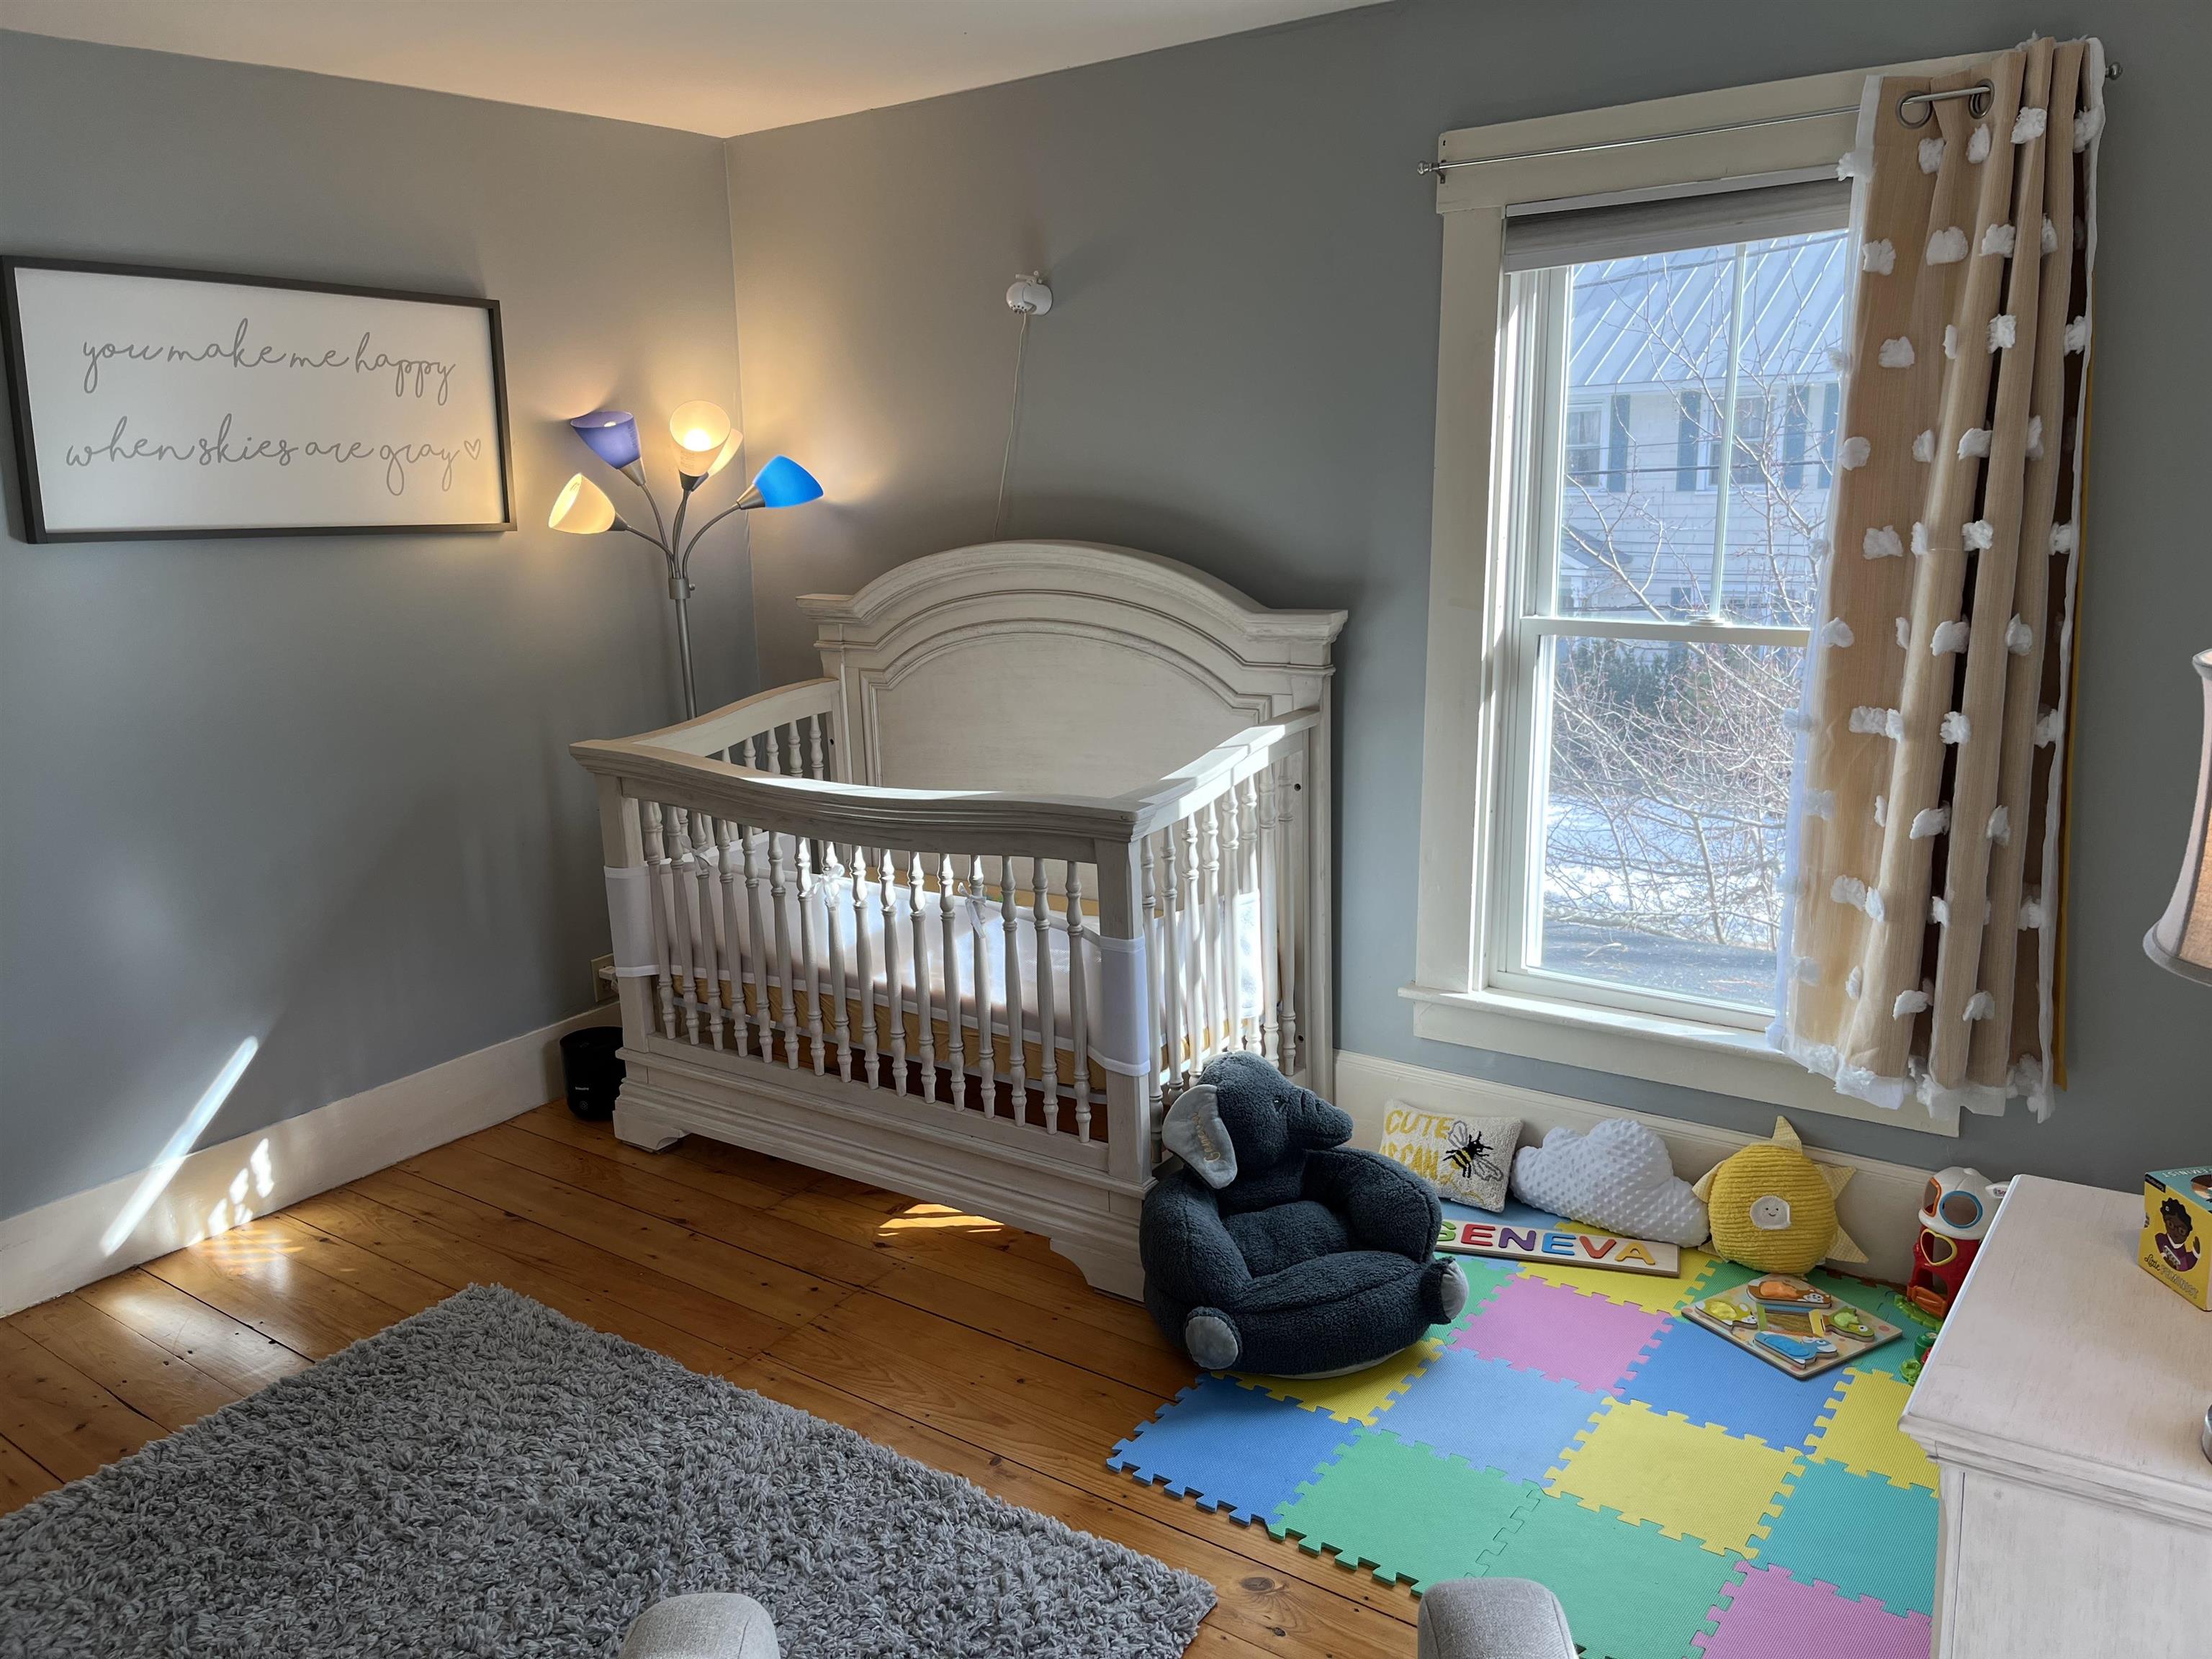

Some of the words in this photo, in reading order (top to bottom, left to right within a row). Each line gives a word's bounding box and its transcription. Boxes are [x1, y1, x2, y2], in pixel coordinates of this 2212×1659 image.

[83, 341, 163, 394] you
[167, 318, 286, 368] make
[289, 349, 349, 368] me
[355, 331, 456, 406] happy
[66, 415, 194, 467] when
[199, 413, 299, 466] skies
[305, 441, 374, 463] are
[379, 444, 460, 495] gray
[1385, 1110, 1455, 1140] CUTE
